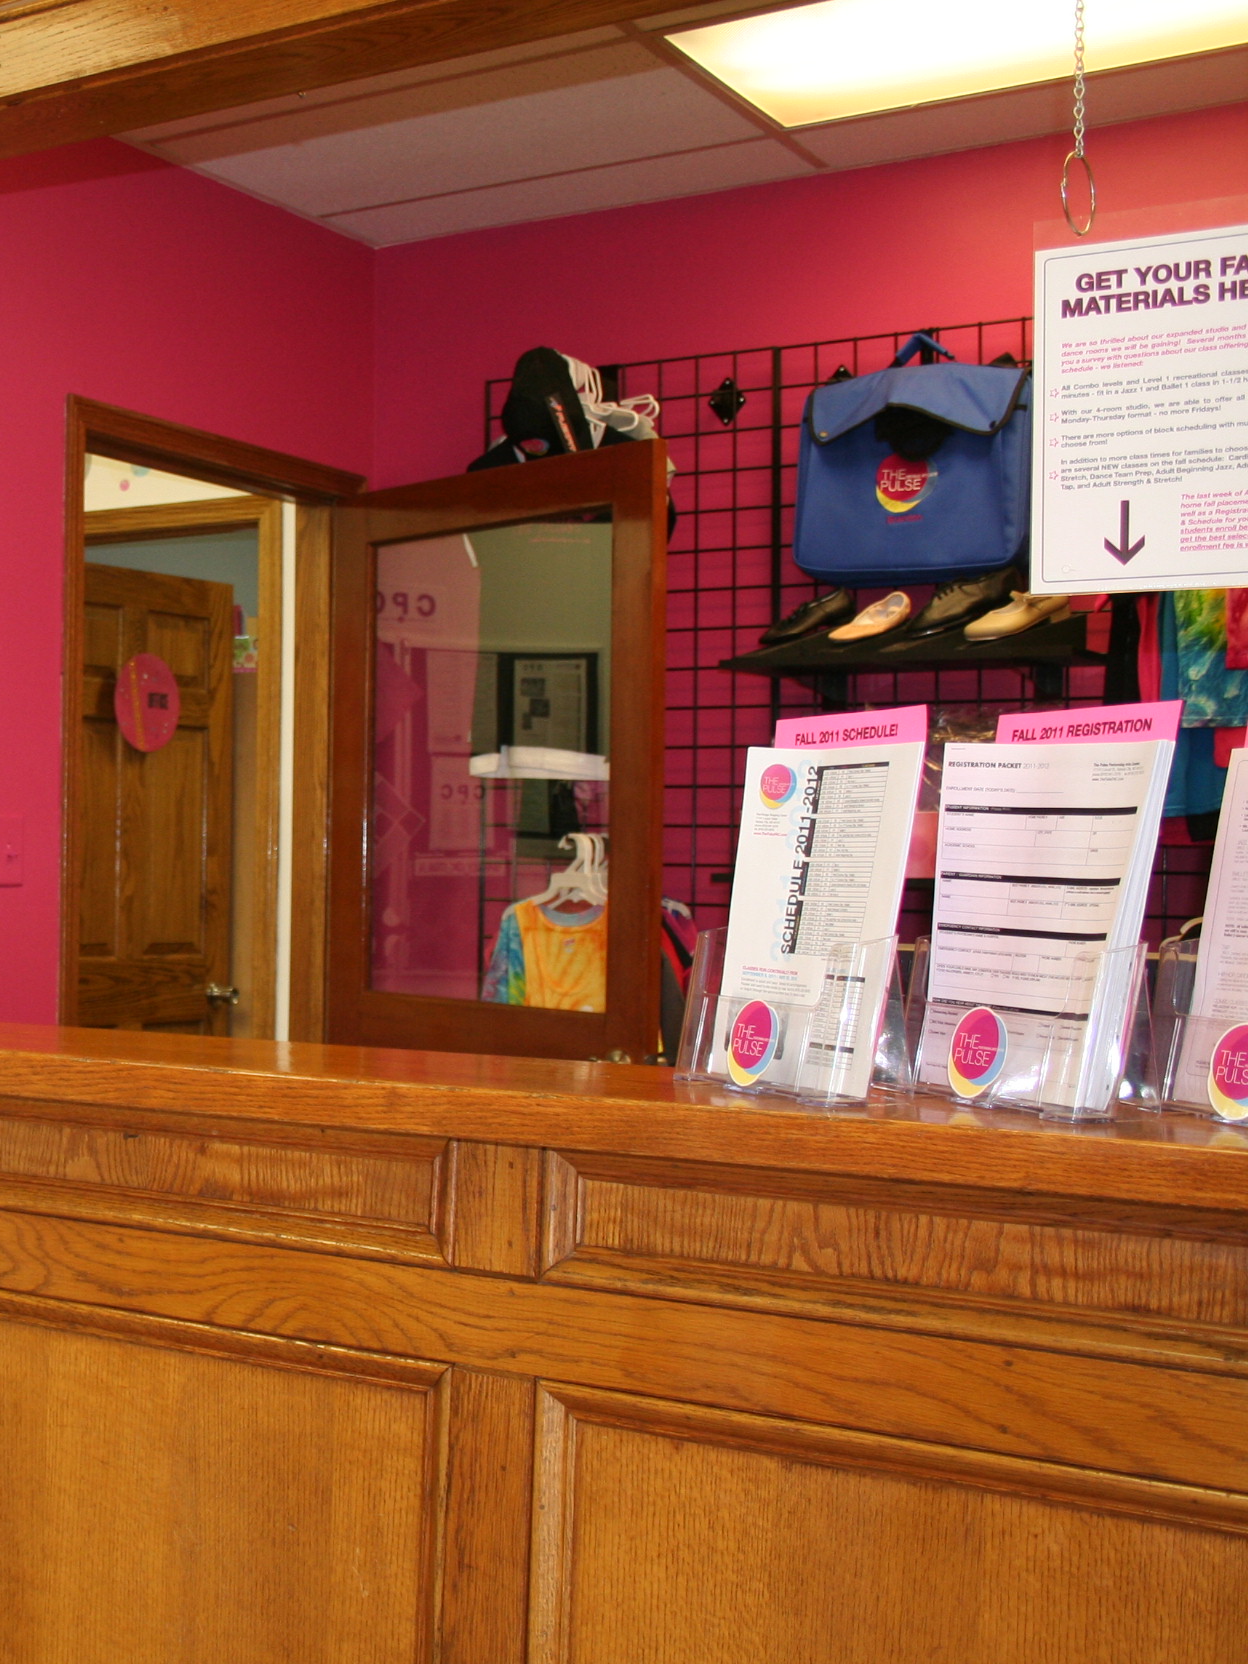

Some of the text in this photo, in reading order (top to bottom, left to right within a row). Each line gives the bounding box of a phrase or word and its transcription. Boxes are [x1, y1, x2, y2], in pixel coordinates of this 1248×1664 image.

[1075, 268, 1128, 293] GET
[1133, 259, 1212, 286] YOUR
[1061, 284, 1211, 319] MATERIALS
[1100, 337, 1126, 345] thrilled
[1127, 334, 1149, 342] about
[1166, 328, 1204, 338] expanded
[1205, 326, 1230, 334] studio
[1231, 323, 1247, 331] and
[1186, 335, 1215, 344] Several
[1217, 333, 1247, 341] months
[1123, 351, 1160, 360] questions
[1160, 348, 1183, 356] about
[1061, 365, 1094, 374] schedule
[1142, 376, 1162, 384] Level
[1172, 371, 1218, 381] recreational
[1061, 414, 1126, 424] Monday-Thursday
[1153, 426, 1174, 434] block
[1176, 423, 1217, 432] scheduling
[1184, 448, 1214, 456] families
[882, 469, 907, 480] THE
[1176, 465, 1214, 474] Beginning
[880, 479, 922, 492] PULSE
[1113, 479, 1144, 487] Strength
[1188, 517, 1223, 525] Schedule
[1180, 525, 1238, 535] students enroll
[1180, 543, 1221, 551] enrollment
[795, 723, 898, 746] FALL 2011 SCHEDULE!
[1011, 718, 1153, 743] FALL 2011 REGISTRATION
[948, 761, 996, 769] REGISTRATION
[764, 777, 780, 786] THE
[762, 784, 786, 794] PULSE
[795, 766, 819, 857] 2011-2012
[781, 859, 804, 955] SCHEDULE
[737, 1023, 756, 1040] THE
[959, 1032, 981, 1049] THE
[733, 1038, 764, 1057] PULSE
[954, 1047, 991, 1067] PULSE
[1221, 1049, 1247, 1068] THE
